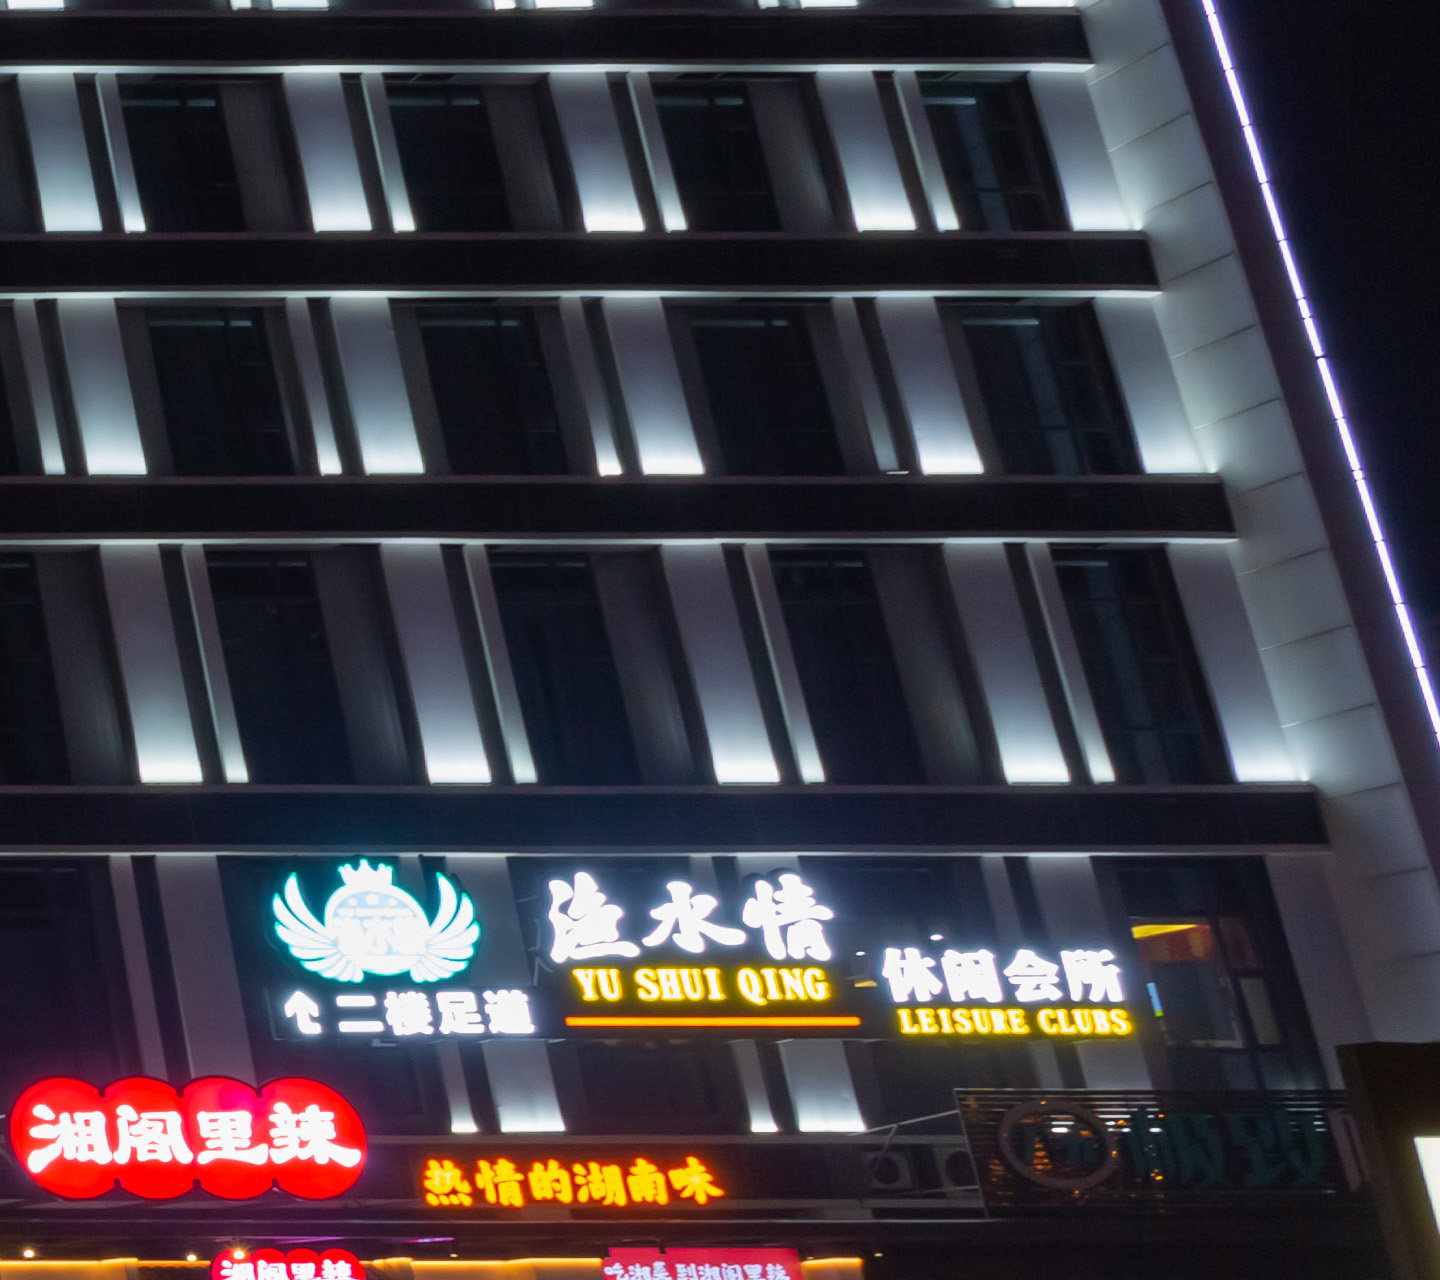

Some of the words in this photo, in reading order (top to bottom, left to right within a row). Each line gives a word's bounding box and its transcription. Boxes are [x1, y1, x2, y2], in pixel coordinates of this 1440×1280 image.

[572, 967, 623, 1003] YU
[634, 966, 728, 1003] SHUI
[736, 966, 833, 1007] QING
[878, 946, 1127, 1005] 休闲会所
[896, 1007, 1031, 1036] LEISURE
[1038, 1007, 1134, 1036] CLUBS
[27, 1101, 362, 1174] 湘阁里辣
[423, 1156, 725, 1208] 热情的湖南味
